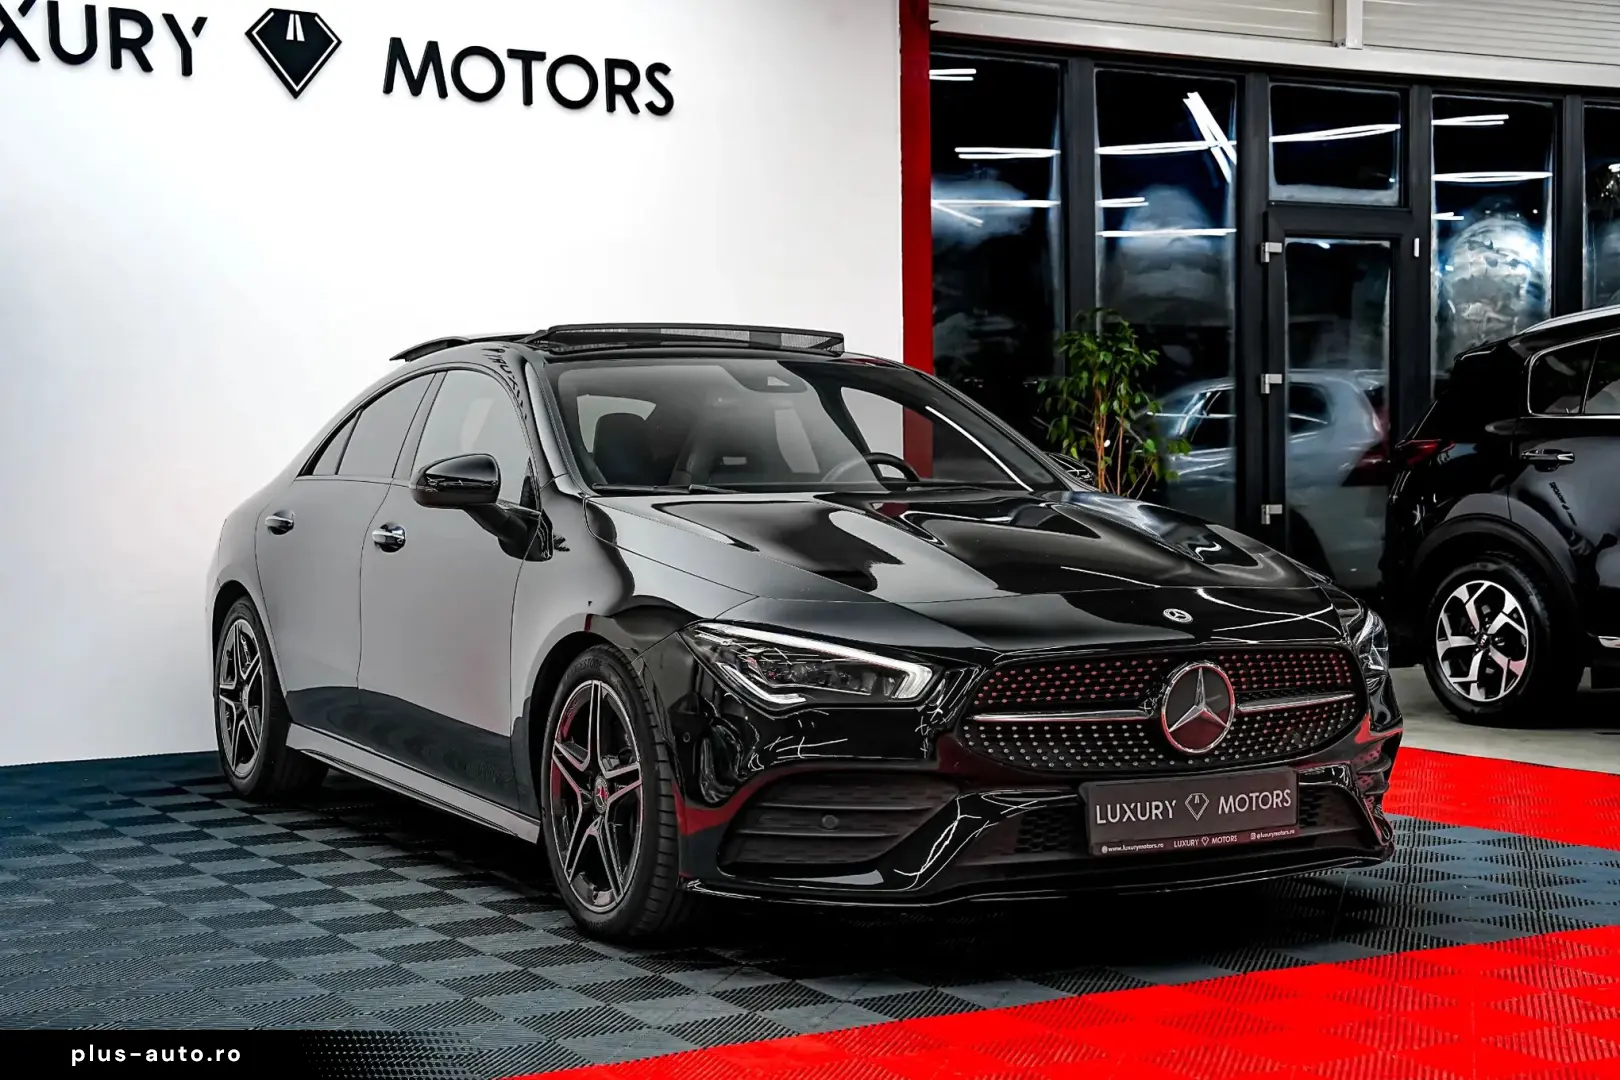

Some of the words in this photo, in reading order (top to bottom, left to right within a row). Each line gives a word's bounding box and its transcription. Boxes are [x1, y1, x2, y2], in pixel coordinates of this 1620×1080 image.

[383, 36, 674, 117] MOTORS
[1096, 799, 1177, 824] LUXURY
[1218, 789, 1292, 815] MOTORS
[1108, 843, 1164, 852] www.luxurymotors.ro
[1173, 839, 1199, 848] LUXURY
[1211, 834, 1238, 844] MOTORS
